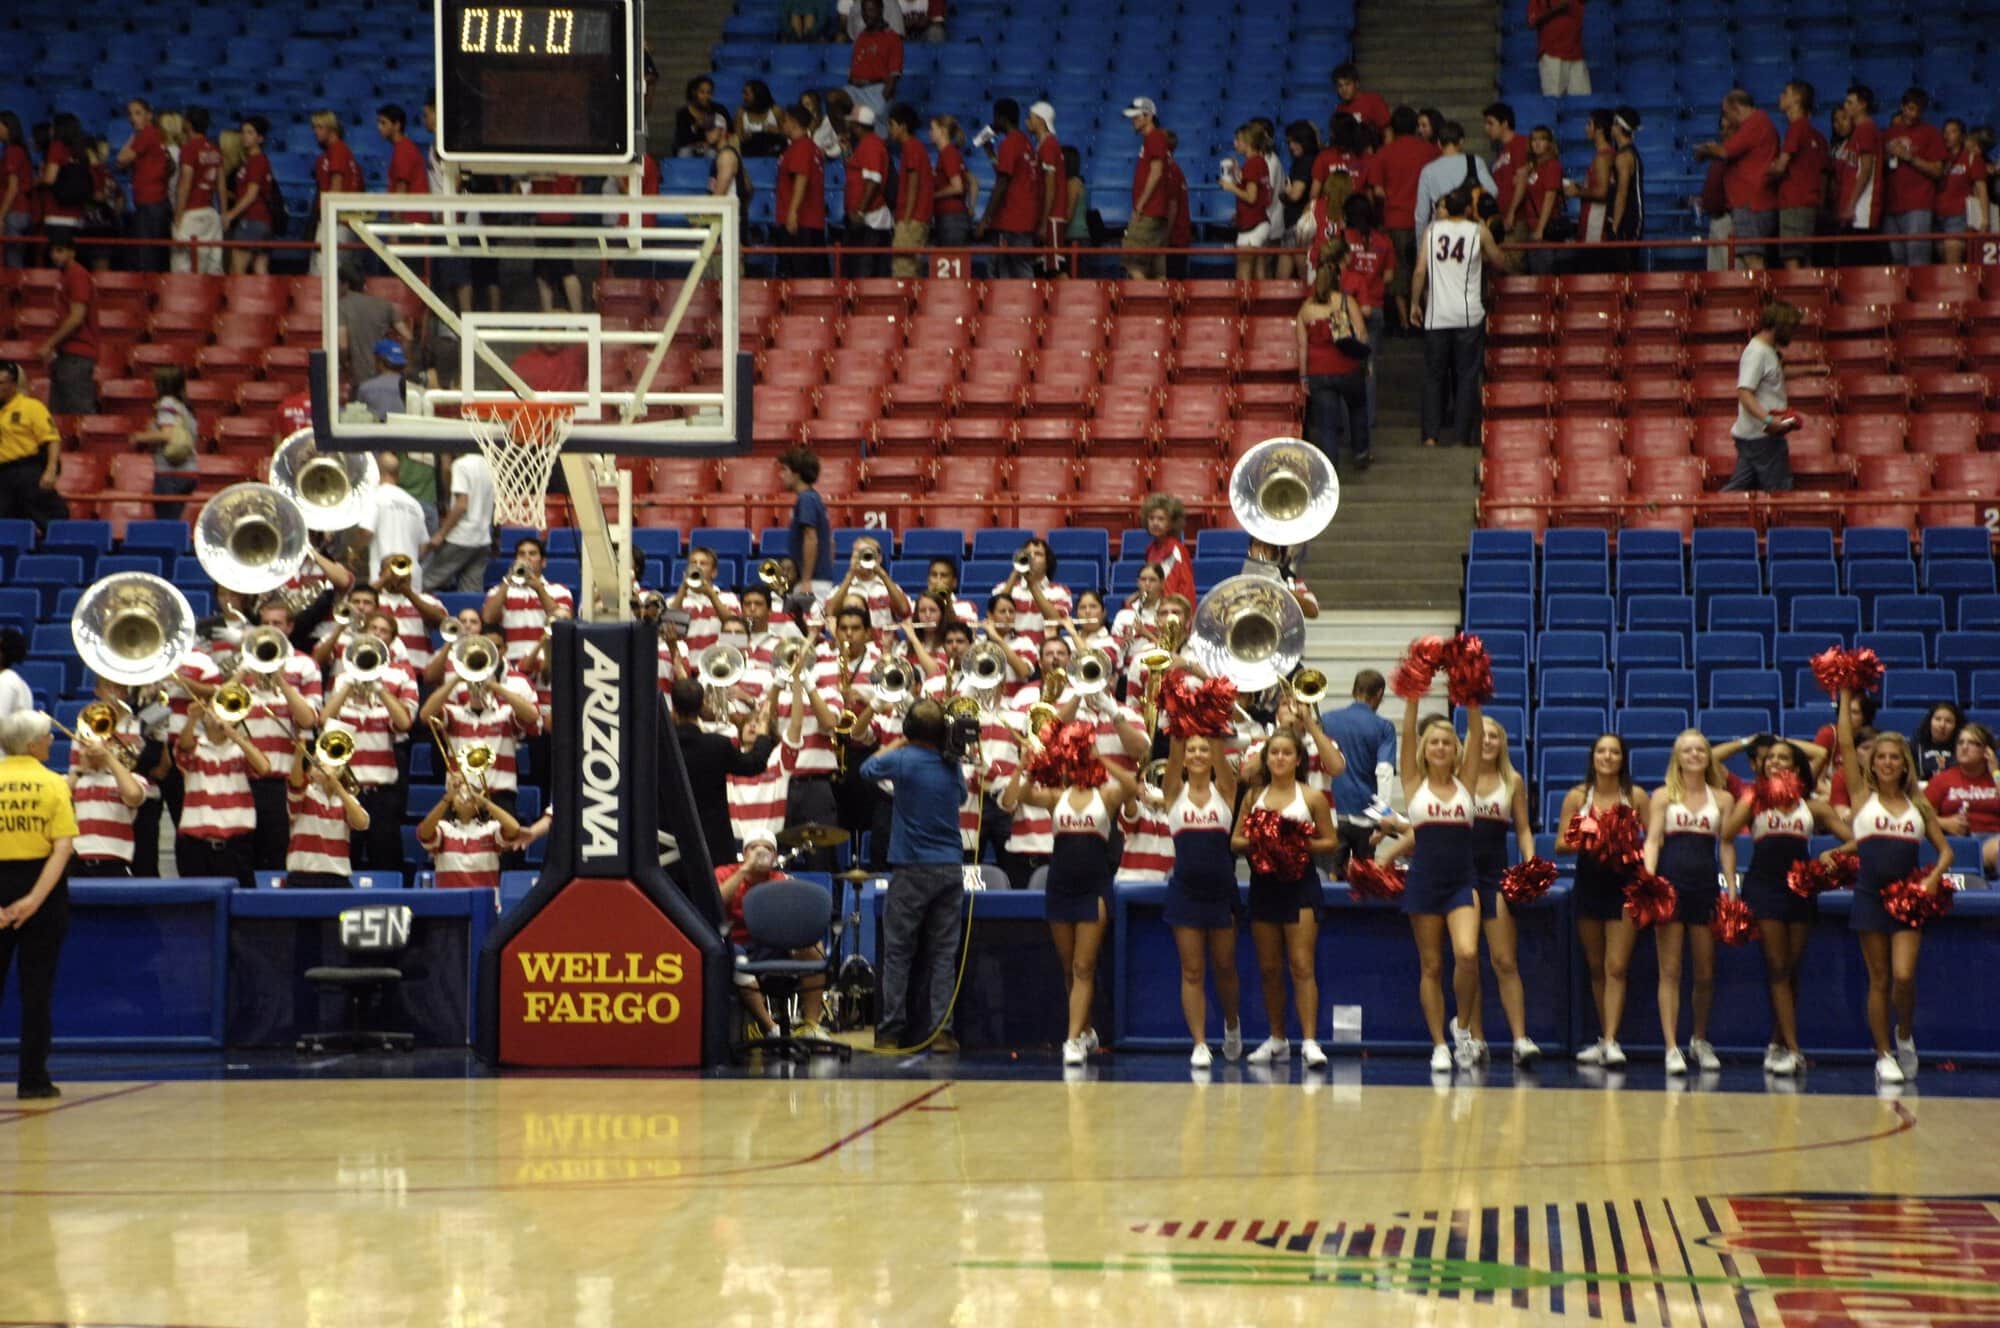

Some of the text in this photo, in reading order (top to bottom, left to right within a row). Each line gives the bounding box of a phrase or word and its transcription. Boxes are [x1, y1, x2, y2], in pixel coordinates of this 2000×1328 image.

[461, 8, 573, 54] 00.0
[1436, 234, 1465, 263] 34
[1983, 242, 2000, 265] 2
[937, 257, 961, 279] 21
[864, 511, 887, 531] 21
[582, 638, 620, 860] ARIZONA
[339, 905, 412, 947] FSN
[517, 952, 683, 984] WELLS
[523, 991, 680, 1024] FARGO
